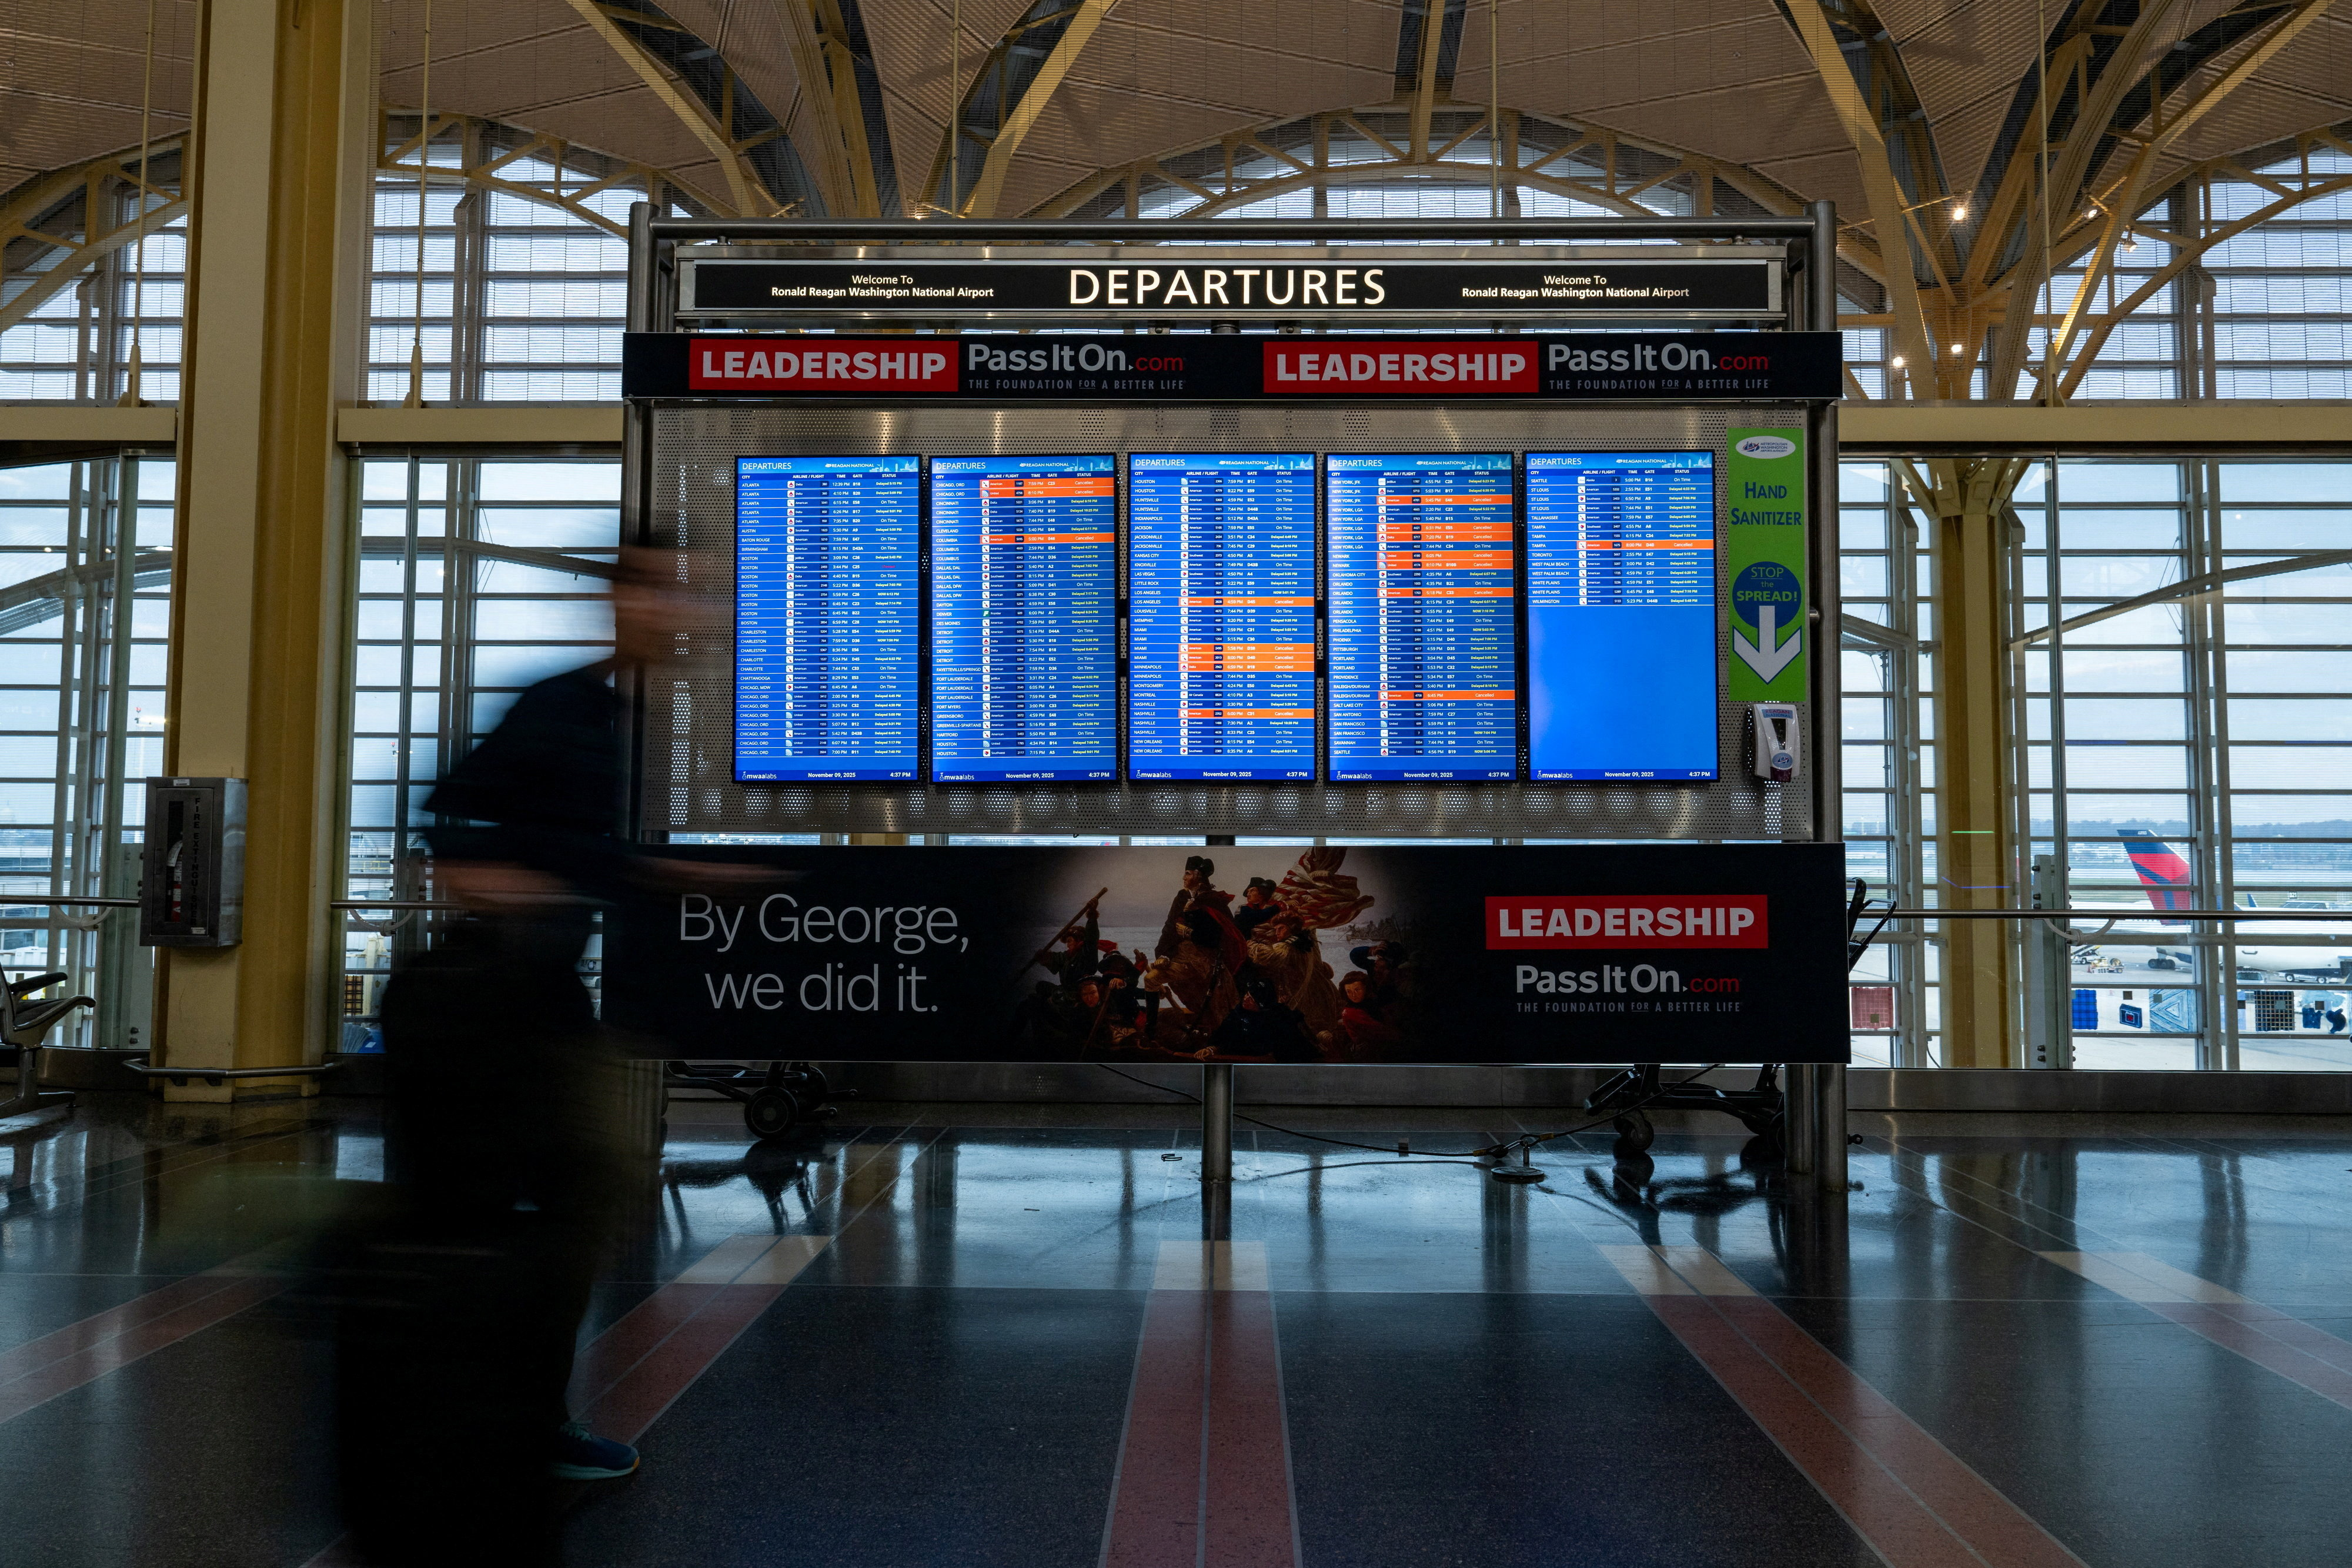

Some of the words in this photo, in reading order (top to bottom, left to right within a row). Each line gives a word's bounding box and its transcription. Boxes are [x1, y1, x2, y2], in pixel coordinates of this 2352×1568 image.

[852, 275, 898, 284] Welcome
[901, 276, 913, 284] To
[1544, 275, 1591, 284] Welcome
[1593, 276, 1606, 284] To
[772, 287, 806, 296] Ronald
[810, 287, 846, 298] Reagan
[849, 287, 909, 298] Washington
[913, 287, 954, 296] National
[957, 287, 993, 298] Airport
[1071, 269, 1385, 305] DEPARTURES
[1463, 287, 1498, 296] Ronald
[1501, 288, 1538, 299] Reagan
[1541, 287, 1603, 299] Washington
[1606, 287, 1649, 297] National
[1652, 287, 1689, 298] Airport
[703, 352, 946, 379] LEADERSHIP
[1277, 354, 1525, 381] LEADERSHIP
[969, 380, 988, 389] THE
[997, 380, 1072, 389] FOUNDATION
[1102, 380, 1108, 389] A
[1115, 380, 1154, 389] BETTER
[1161, 380, 1182, 389] LIFE
[1549, 380, 1569, 389] THE
[1578, 380, 1655, 389] FOUNDATION
[1685, 380, 1691, 389] A
[1698, 379, 1738, 389] BETTER
[1746, 379, 1768, 388] LIFE
[1745, 482, 1788, 499] HAND
[1731, 508, 1802, 525] SANITIZER
[1751, 567, 1783, 578] STOP
[1736, 591, 1797, 601] SPREAD!
[191, 833, 199, 925] EXTINGUISHER
[681, 894, 744, 952] By
[760, 894, 968, 954] George,
[1499, 907, 1754, 937] LEADERSHIP
[705, 974, 784, 1009] we
[800, 962, 878, 1011] did
[898, 964, 937, 1012] it.
[1517, 1003, 1538, 1012] THE
[1546, 1002, 1624, 1012] FOUNDATION
[1655, 1002, 1661, 1011] A
[1668, 1002, 1709, 1011] BETTER
[1717, 1002, 1739, 1011] LIFE
